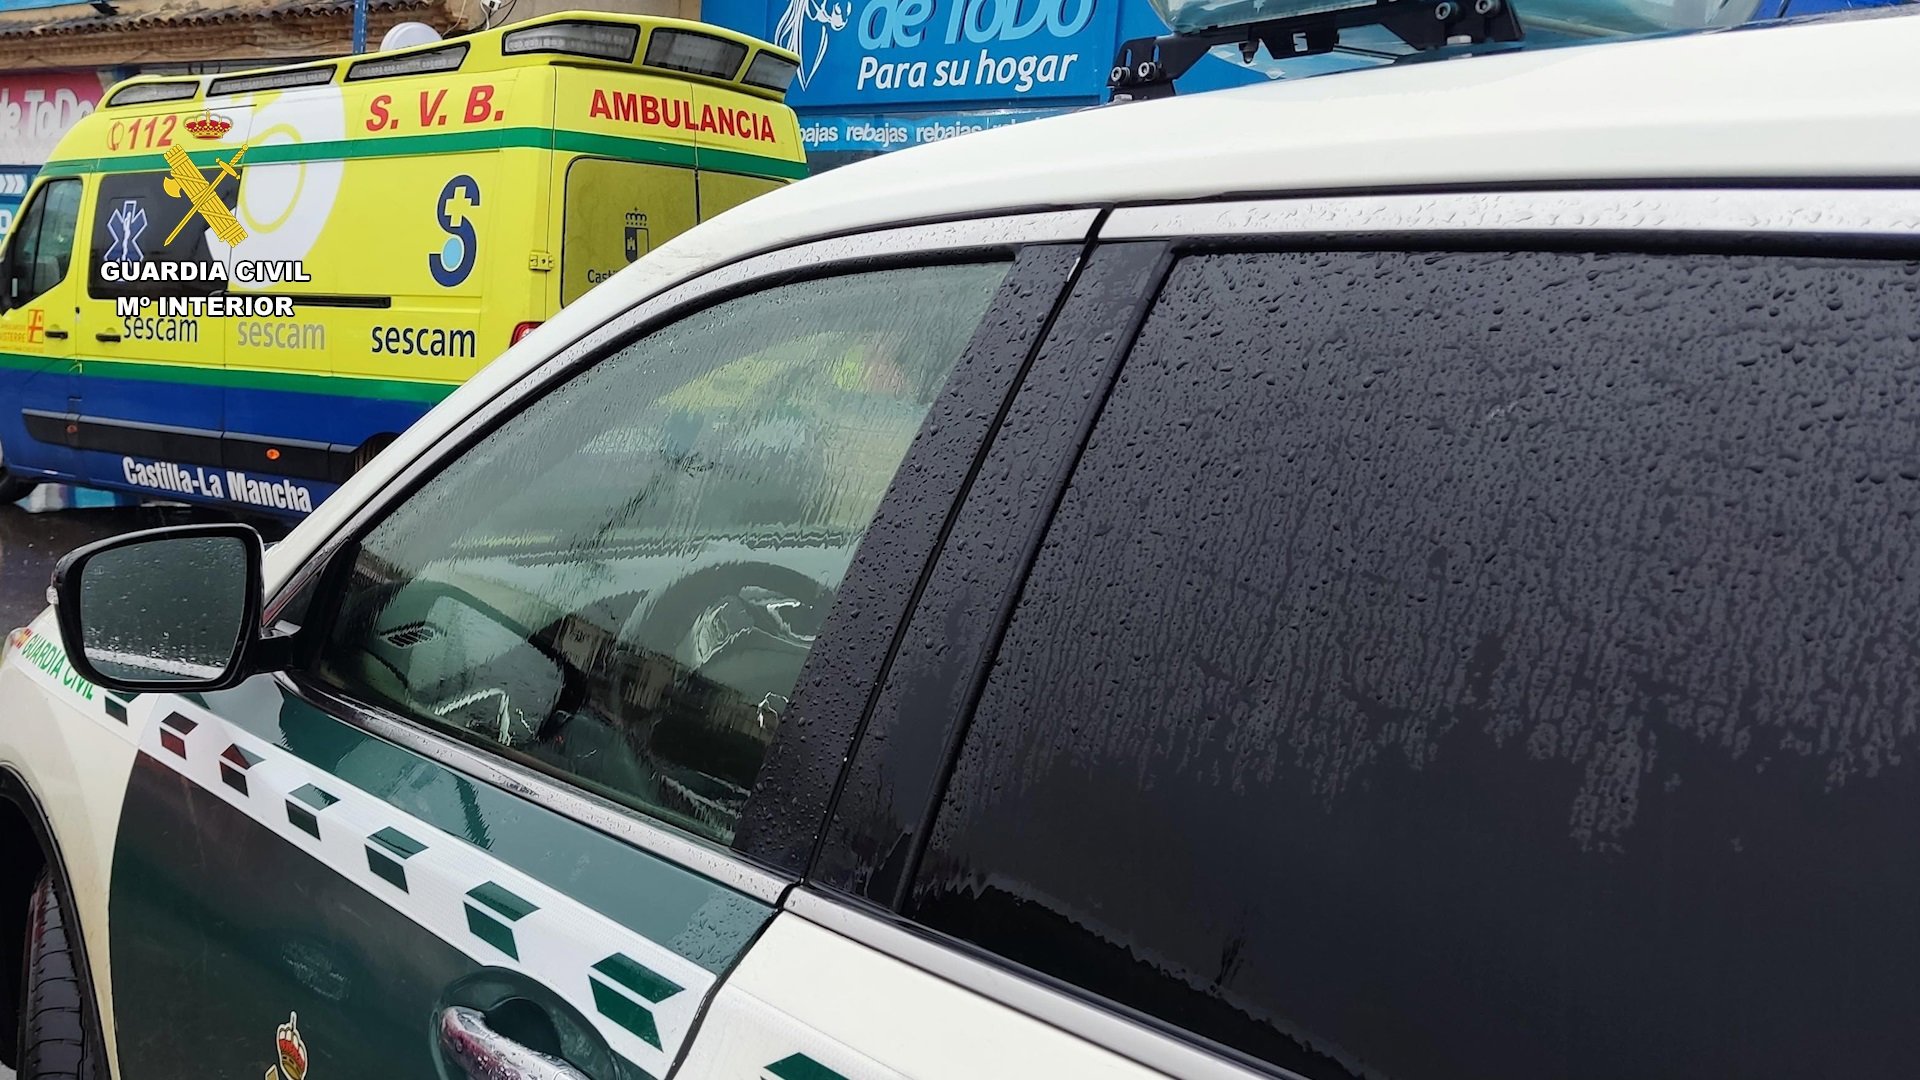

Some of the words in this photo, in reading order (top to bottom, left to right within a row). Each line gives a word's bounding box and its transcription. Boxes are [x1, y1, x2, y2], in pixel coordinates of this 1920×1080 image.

[857, 56, 927, 90] Para
[933, 59, 970, 86] su
[975, 49, 1078, 92] hogar
[366, 95, 399, 132] S.
[420, 89, 448, 127] V.
[464, 85, 504, 123] B.
[589, 89, 776, 143] AMBULANCIA
[128, 114, 177, 150] 112
[846, 123, 909, 147] rebajas
[124, 316, 198, 342] sescam
[237, 321, 325, 350] sescam
[371, 326, 476, 358] sescam
[123, 456, 225, 498] Castilla-La
[226, 471, 313, 513] Mancha
[22, 633, 67, 679] GUARDIA
[63, 666, 94, 700] CIVIL
